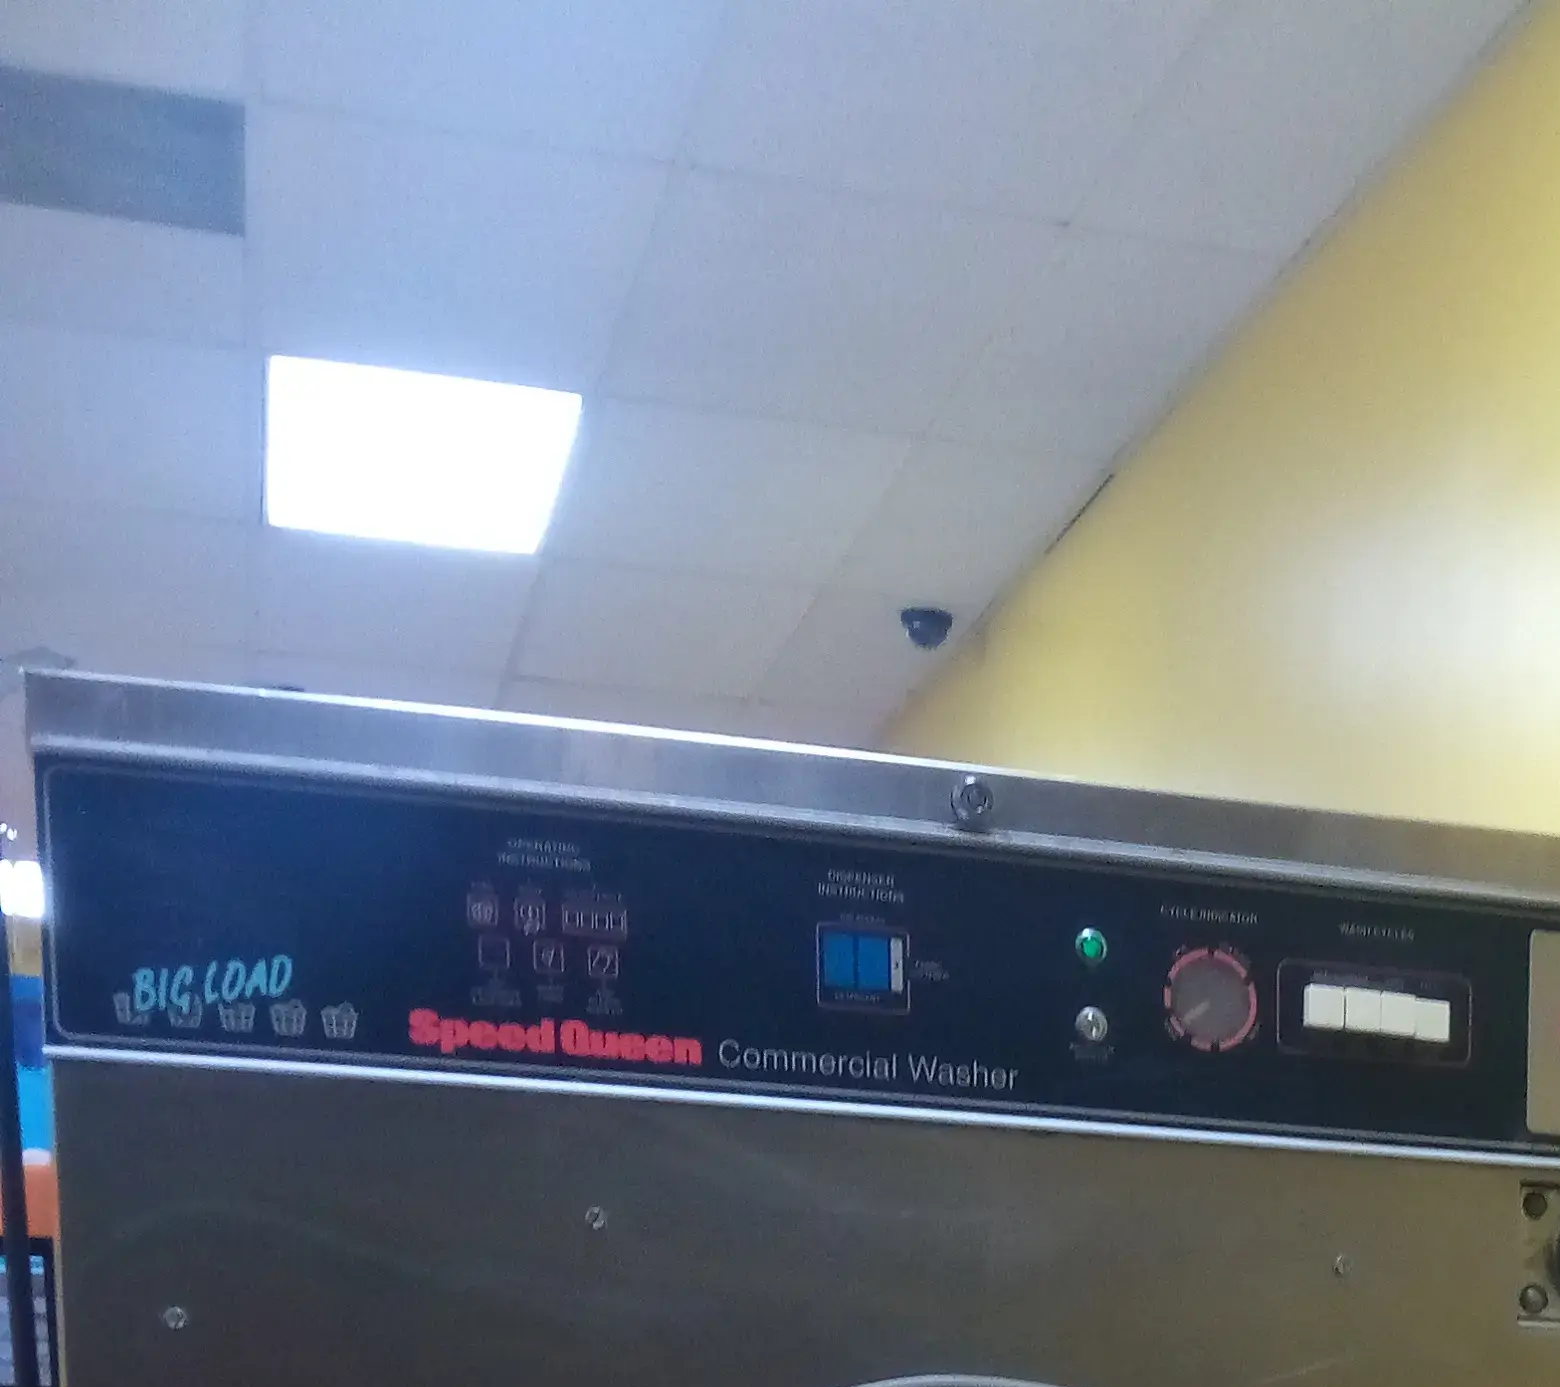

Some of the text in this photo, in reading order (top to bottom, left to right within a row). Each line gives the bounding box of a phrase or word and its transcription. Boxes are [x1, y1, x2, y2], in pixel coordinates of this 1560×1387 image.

[133, 954, 293, 1014] BIG LOAD
[409, 1007, 702, 1065] Speed Queen
[719, 1038, 1018, 1091] Commercial Washer
